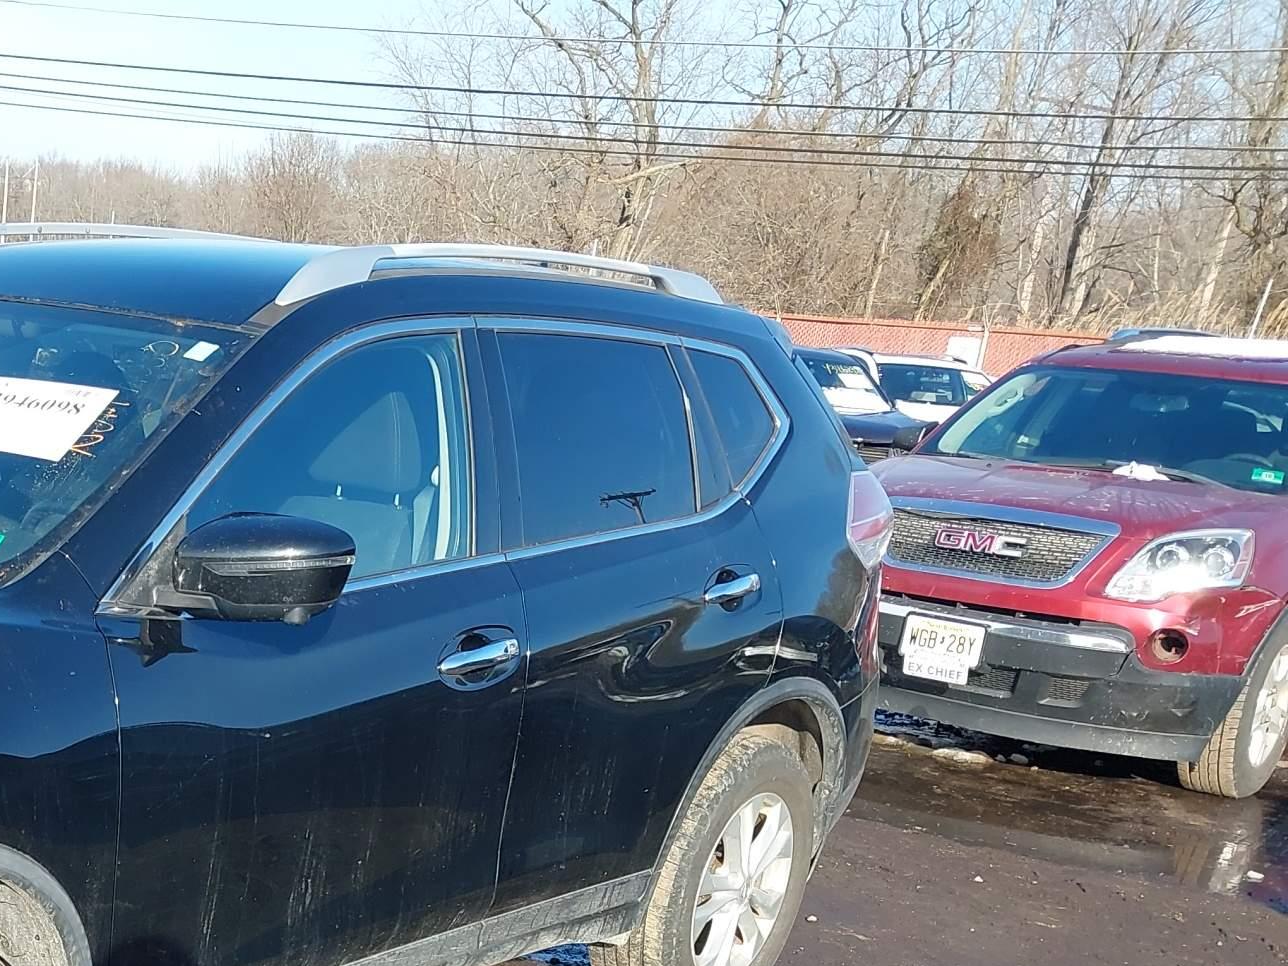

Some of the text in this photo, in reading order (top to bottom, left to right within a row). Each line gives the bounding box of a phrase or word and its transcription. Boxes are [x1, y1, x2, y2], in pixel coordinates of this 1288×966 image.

[934, 528, 1028, 558] GMC
[907, 661, 964, 681] EX CHIEF
